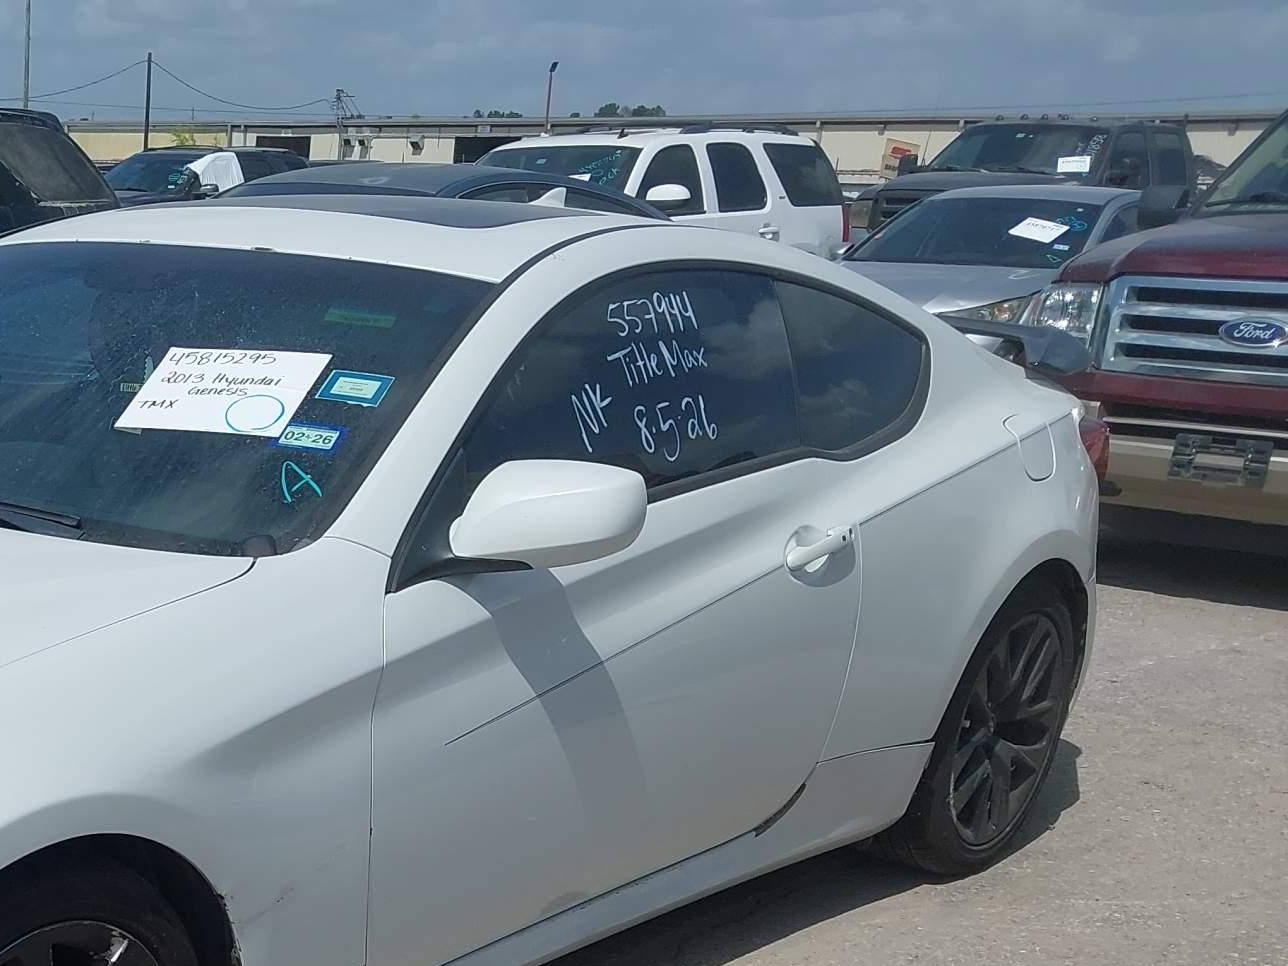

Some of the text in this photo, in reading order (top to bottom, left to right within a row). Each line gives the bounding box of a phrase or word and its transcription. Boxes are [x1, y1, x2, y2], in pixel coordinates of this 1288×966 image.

[607, 291, 698, 336] 557944
[1233, 322, 1276, 339] Ford
[169, 351, 278, 366] 45815295
[160, 370, 284, 387] 2013 Hyundai
[138, 399, 178, 410] TMX
[284, 430, 334, 445] 02 26
[280, 460, 323, 504] A
